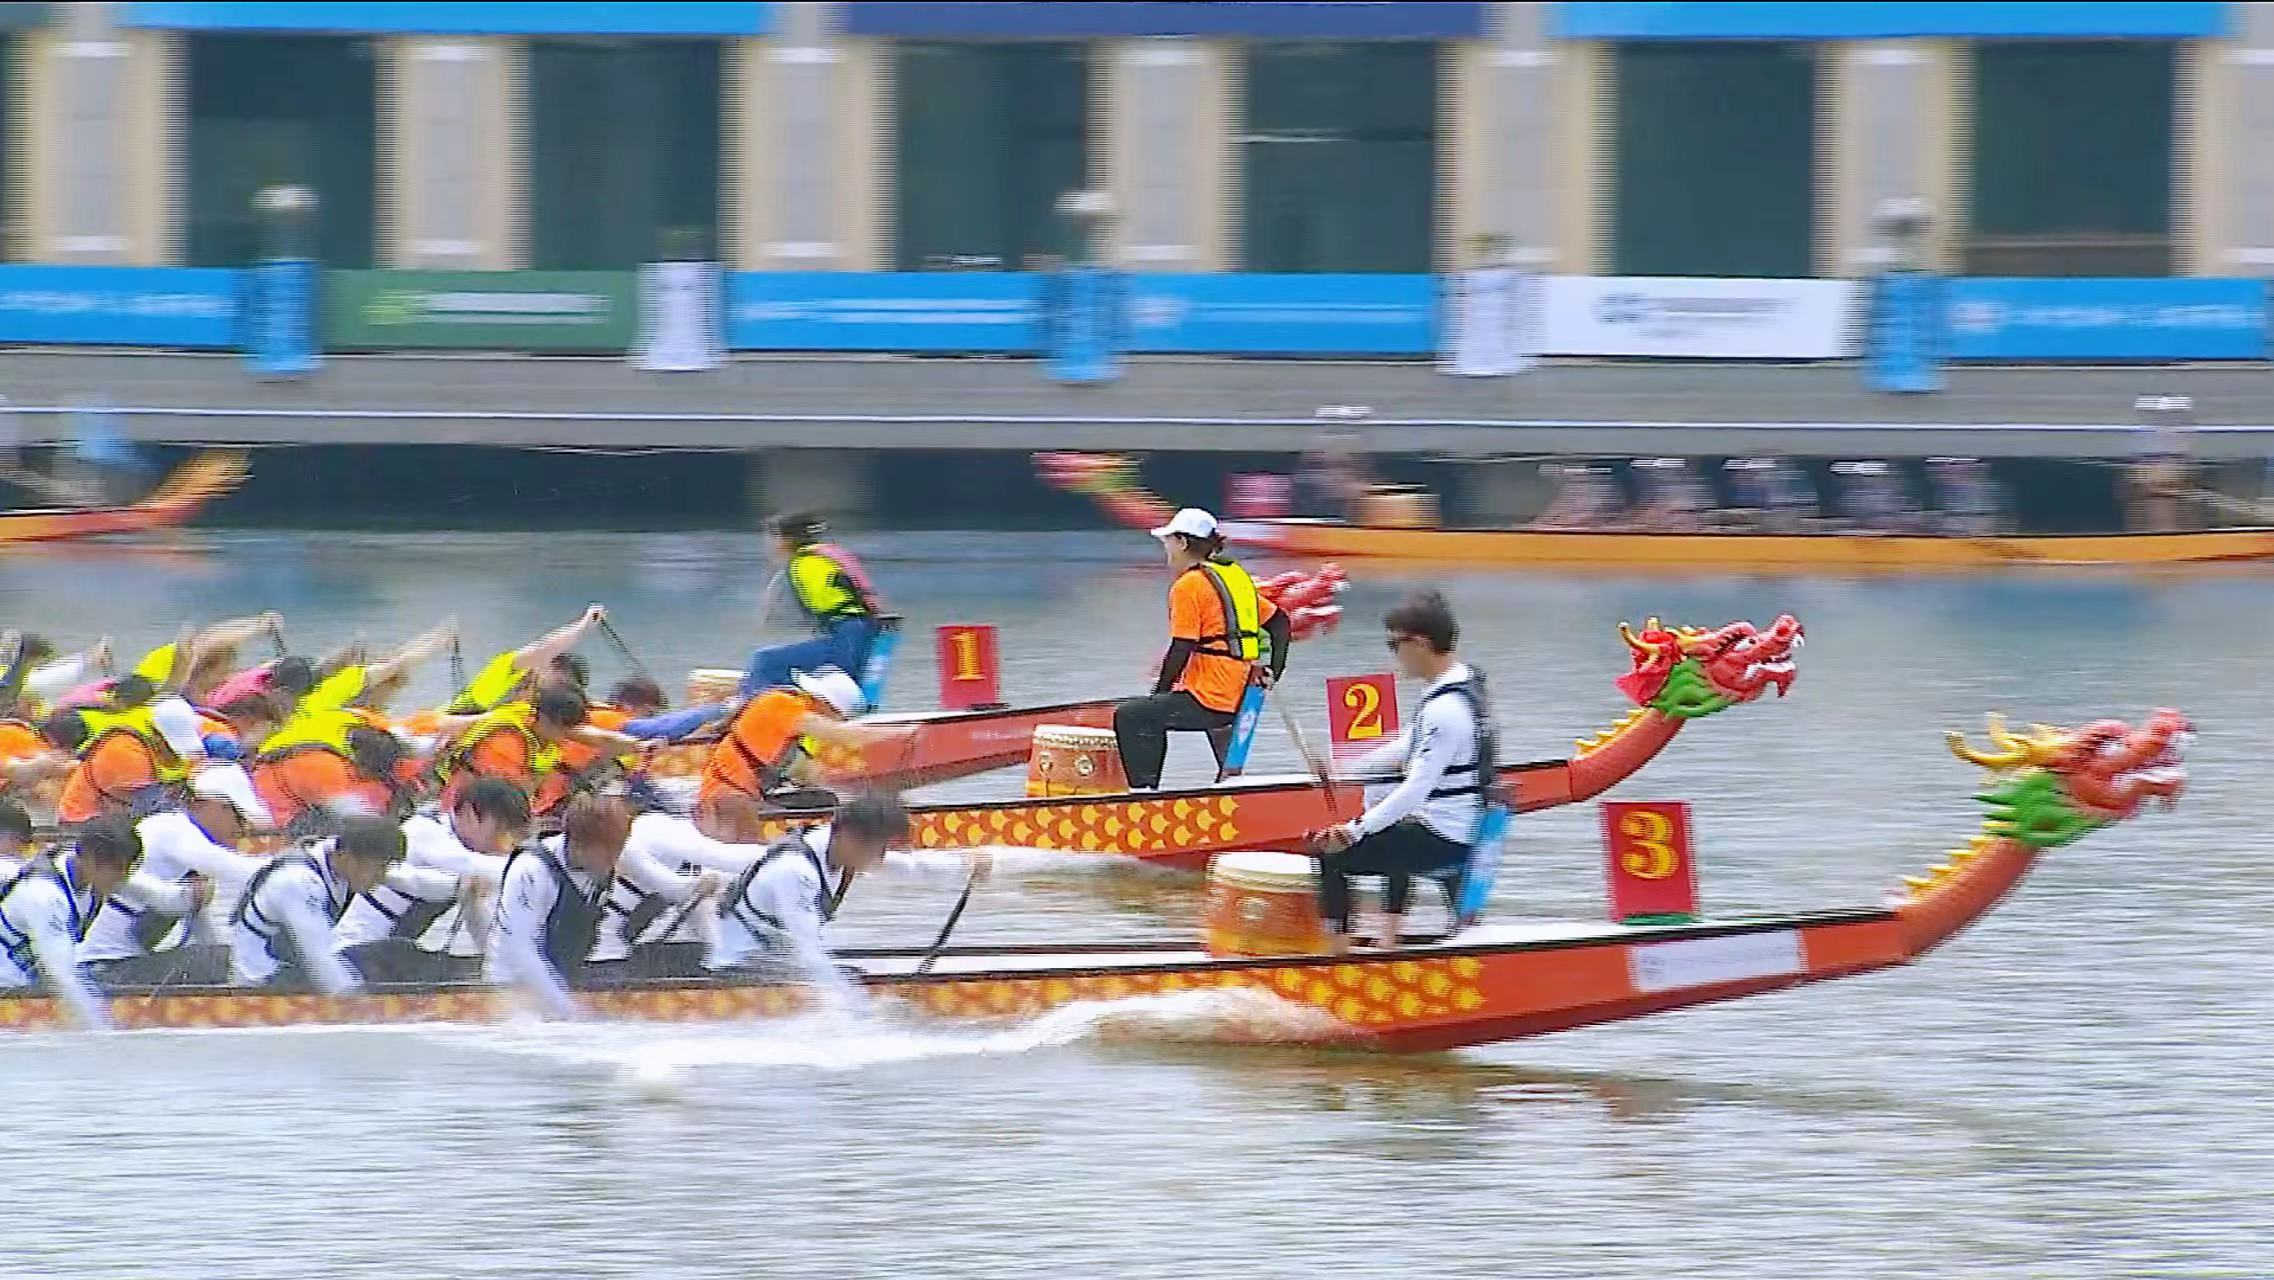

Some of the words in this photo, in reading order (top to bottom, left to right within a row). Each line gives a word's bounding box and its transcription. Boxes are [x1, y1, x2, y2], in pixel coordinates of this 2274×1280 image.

[951, 632, 986, 680] 1
[1344, 683, 1383, 739] 2
[1619, 811, 1679, 879] 3
